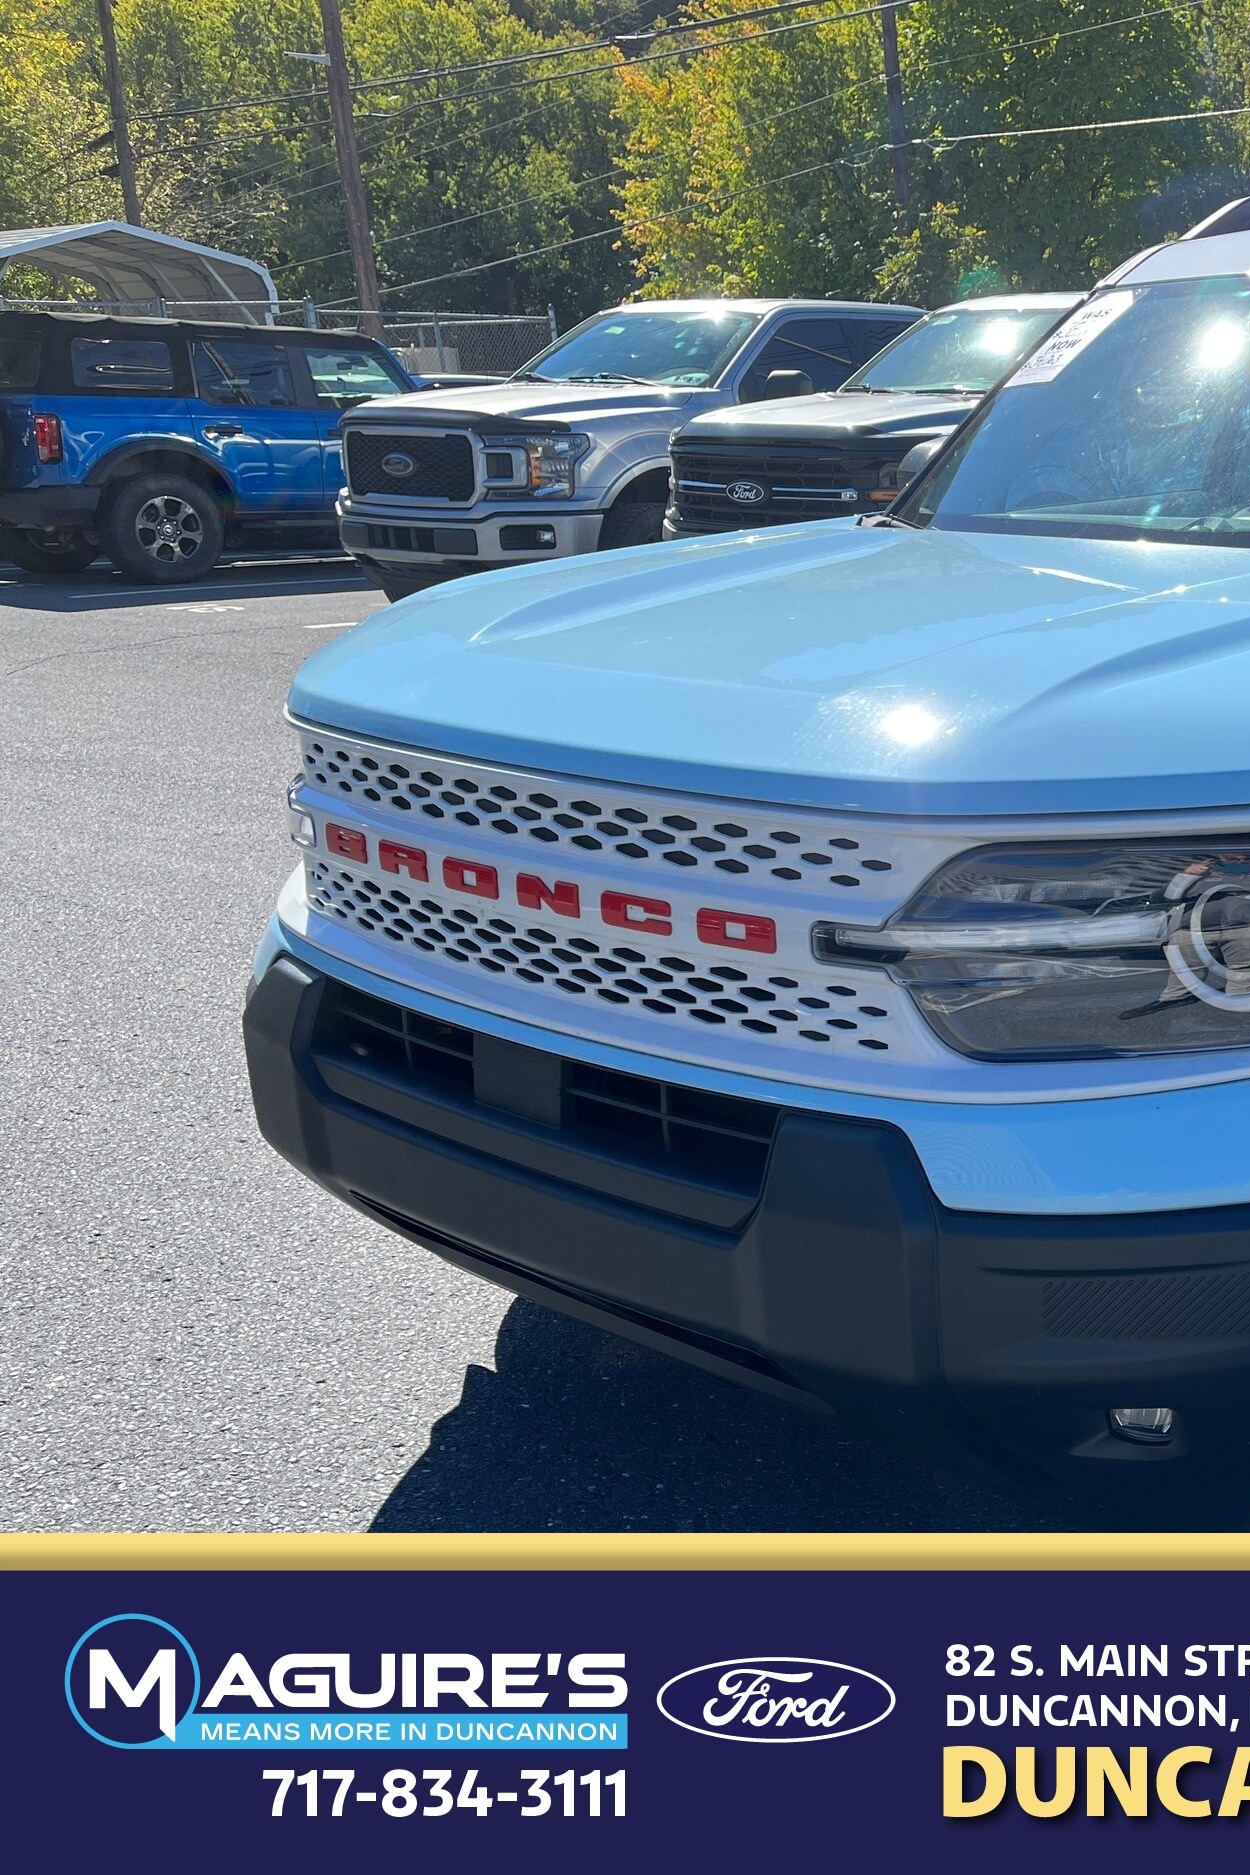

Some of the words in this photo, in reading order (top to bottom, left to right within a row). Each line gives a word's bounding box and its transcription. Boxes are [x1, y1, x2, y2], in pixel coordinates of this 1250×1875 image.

[1081, 308, 1113, 320] WAS
[1048, 339, 1082, 352] NOW
[733, 484, 757, 500] Ford
[326, 822, 777, 955] BRONCO
